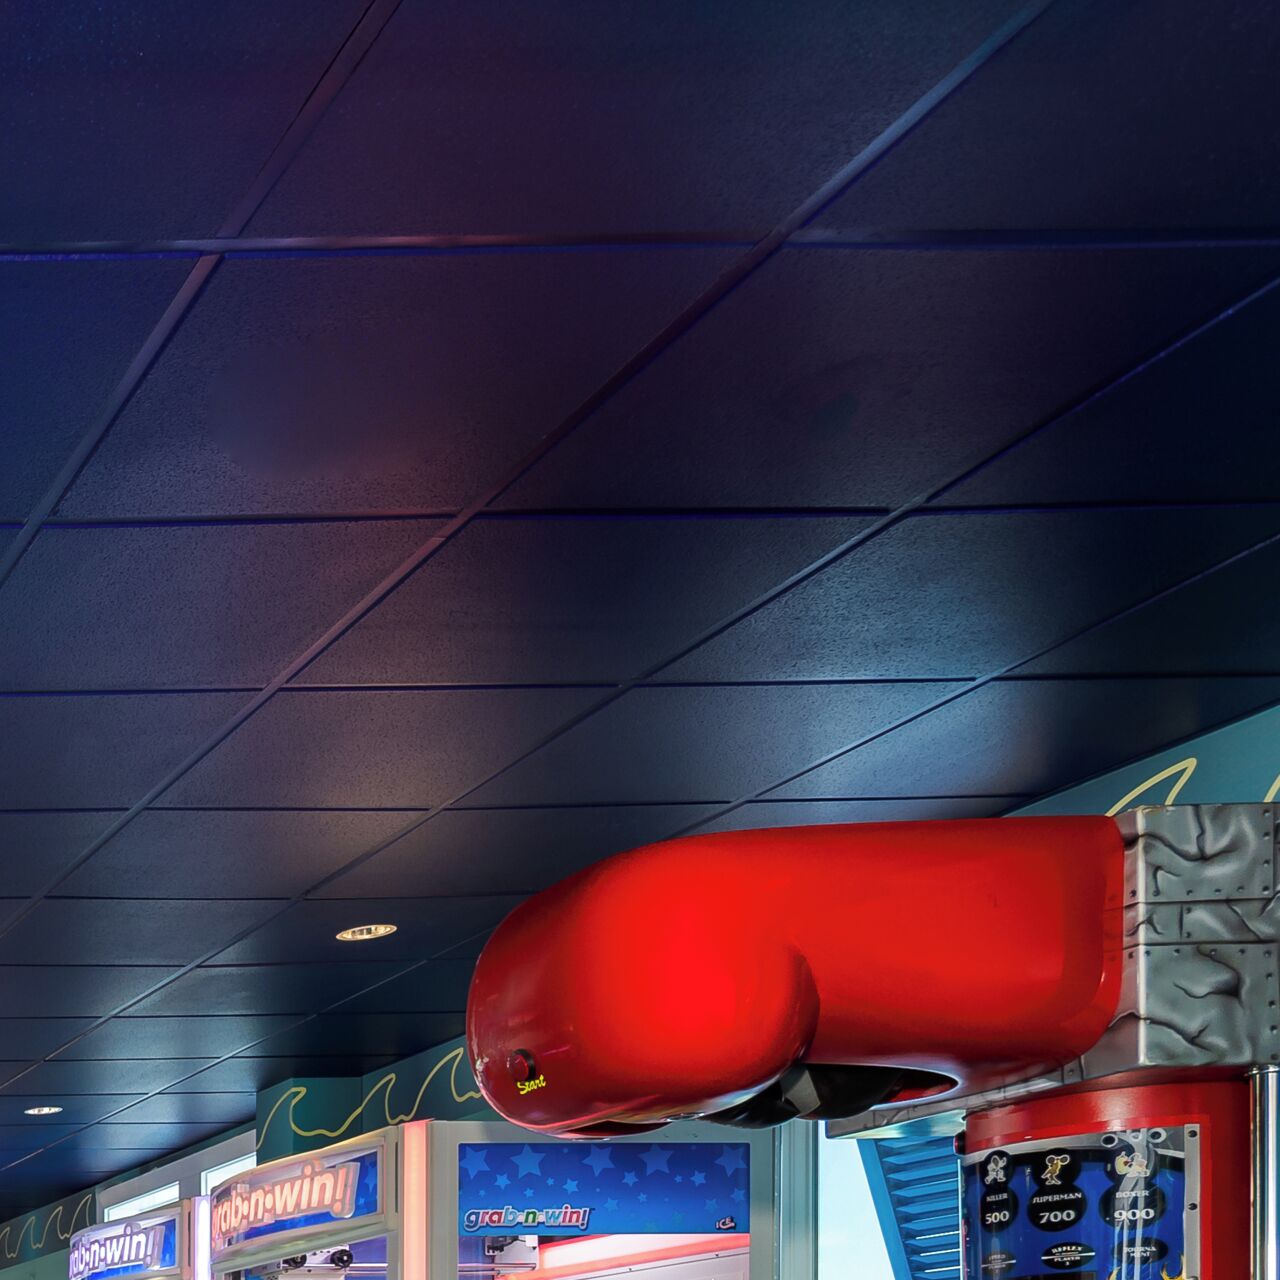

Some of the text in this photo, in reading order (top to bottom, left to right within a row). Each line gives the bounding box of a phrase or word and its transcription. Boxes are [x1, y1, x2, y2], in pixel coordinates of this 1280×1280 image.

[1032, 1192, 1082, 1204] SUPERMAN
[985, 1211, 1010, 1224] 500
[1040, 1209, 1075, 1224] 700
[1113, 1208, 1155, 1221] 900
